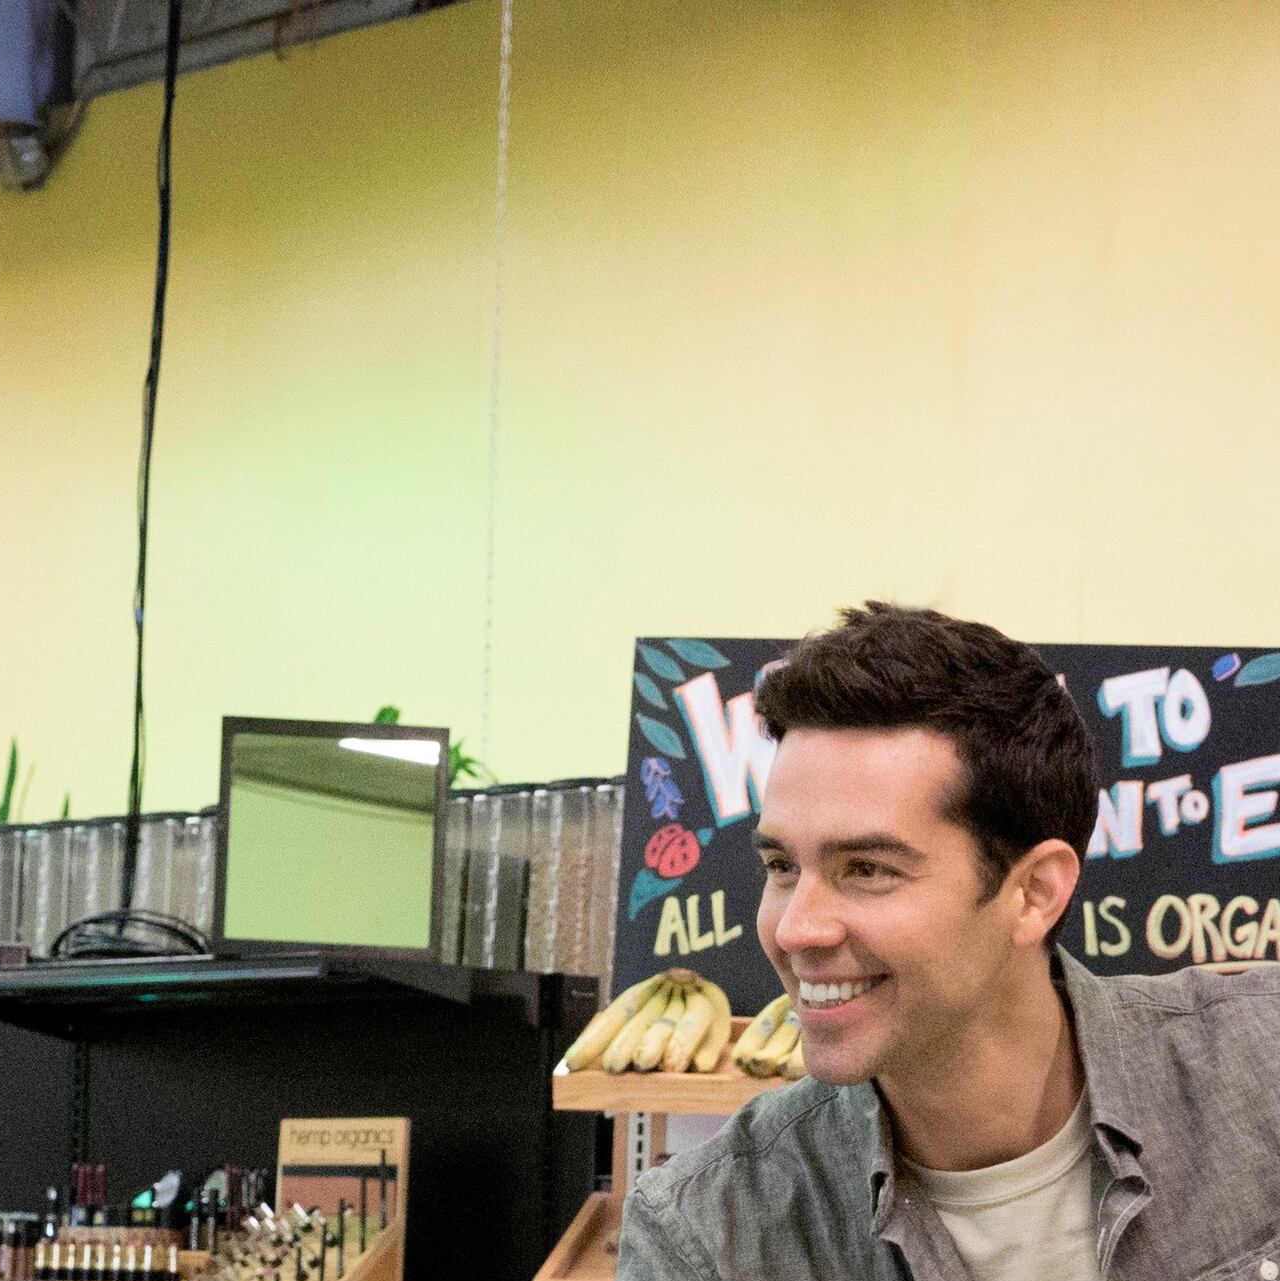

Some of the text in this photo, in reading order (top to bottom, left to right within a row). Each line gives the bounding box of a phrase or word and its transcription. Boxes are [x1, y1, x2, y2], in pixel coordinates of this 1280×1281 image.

[1098, 666, 1212, 767] TO
[654, 890, 743, 956] ALL
[1083, 895, 1132, 956] IS
